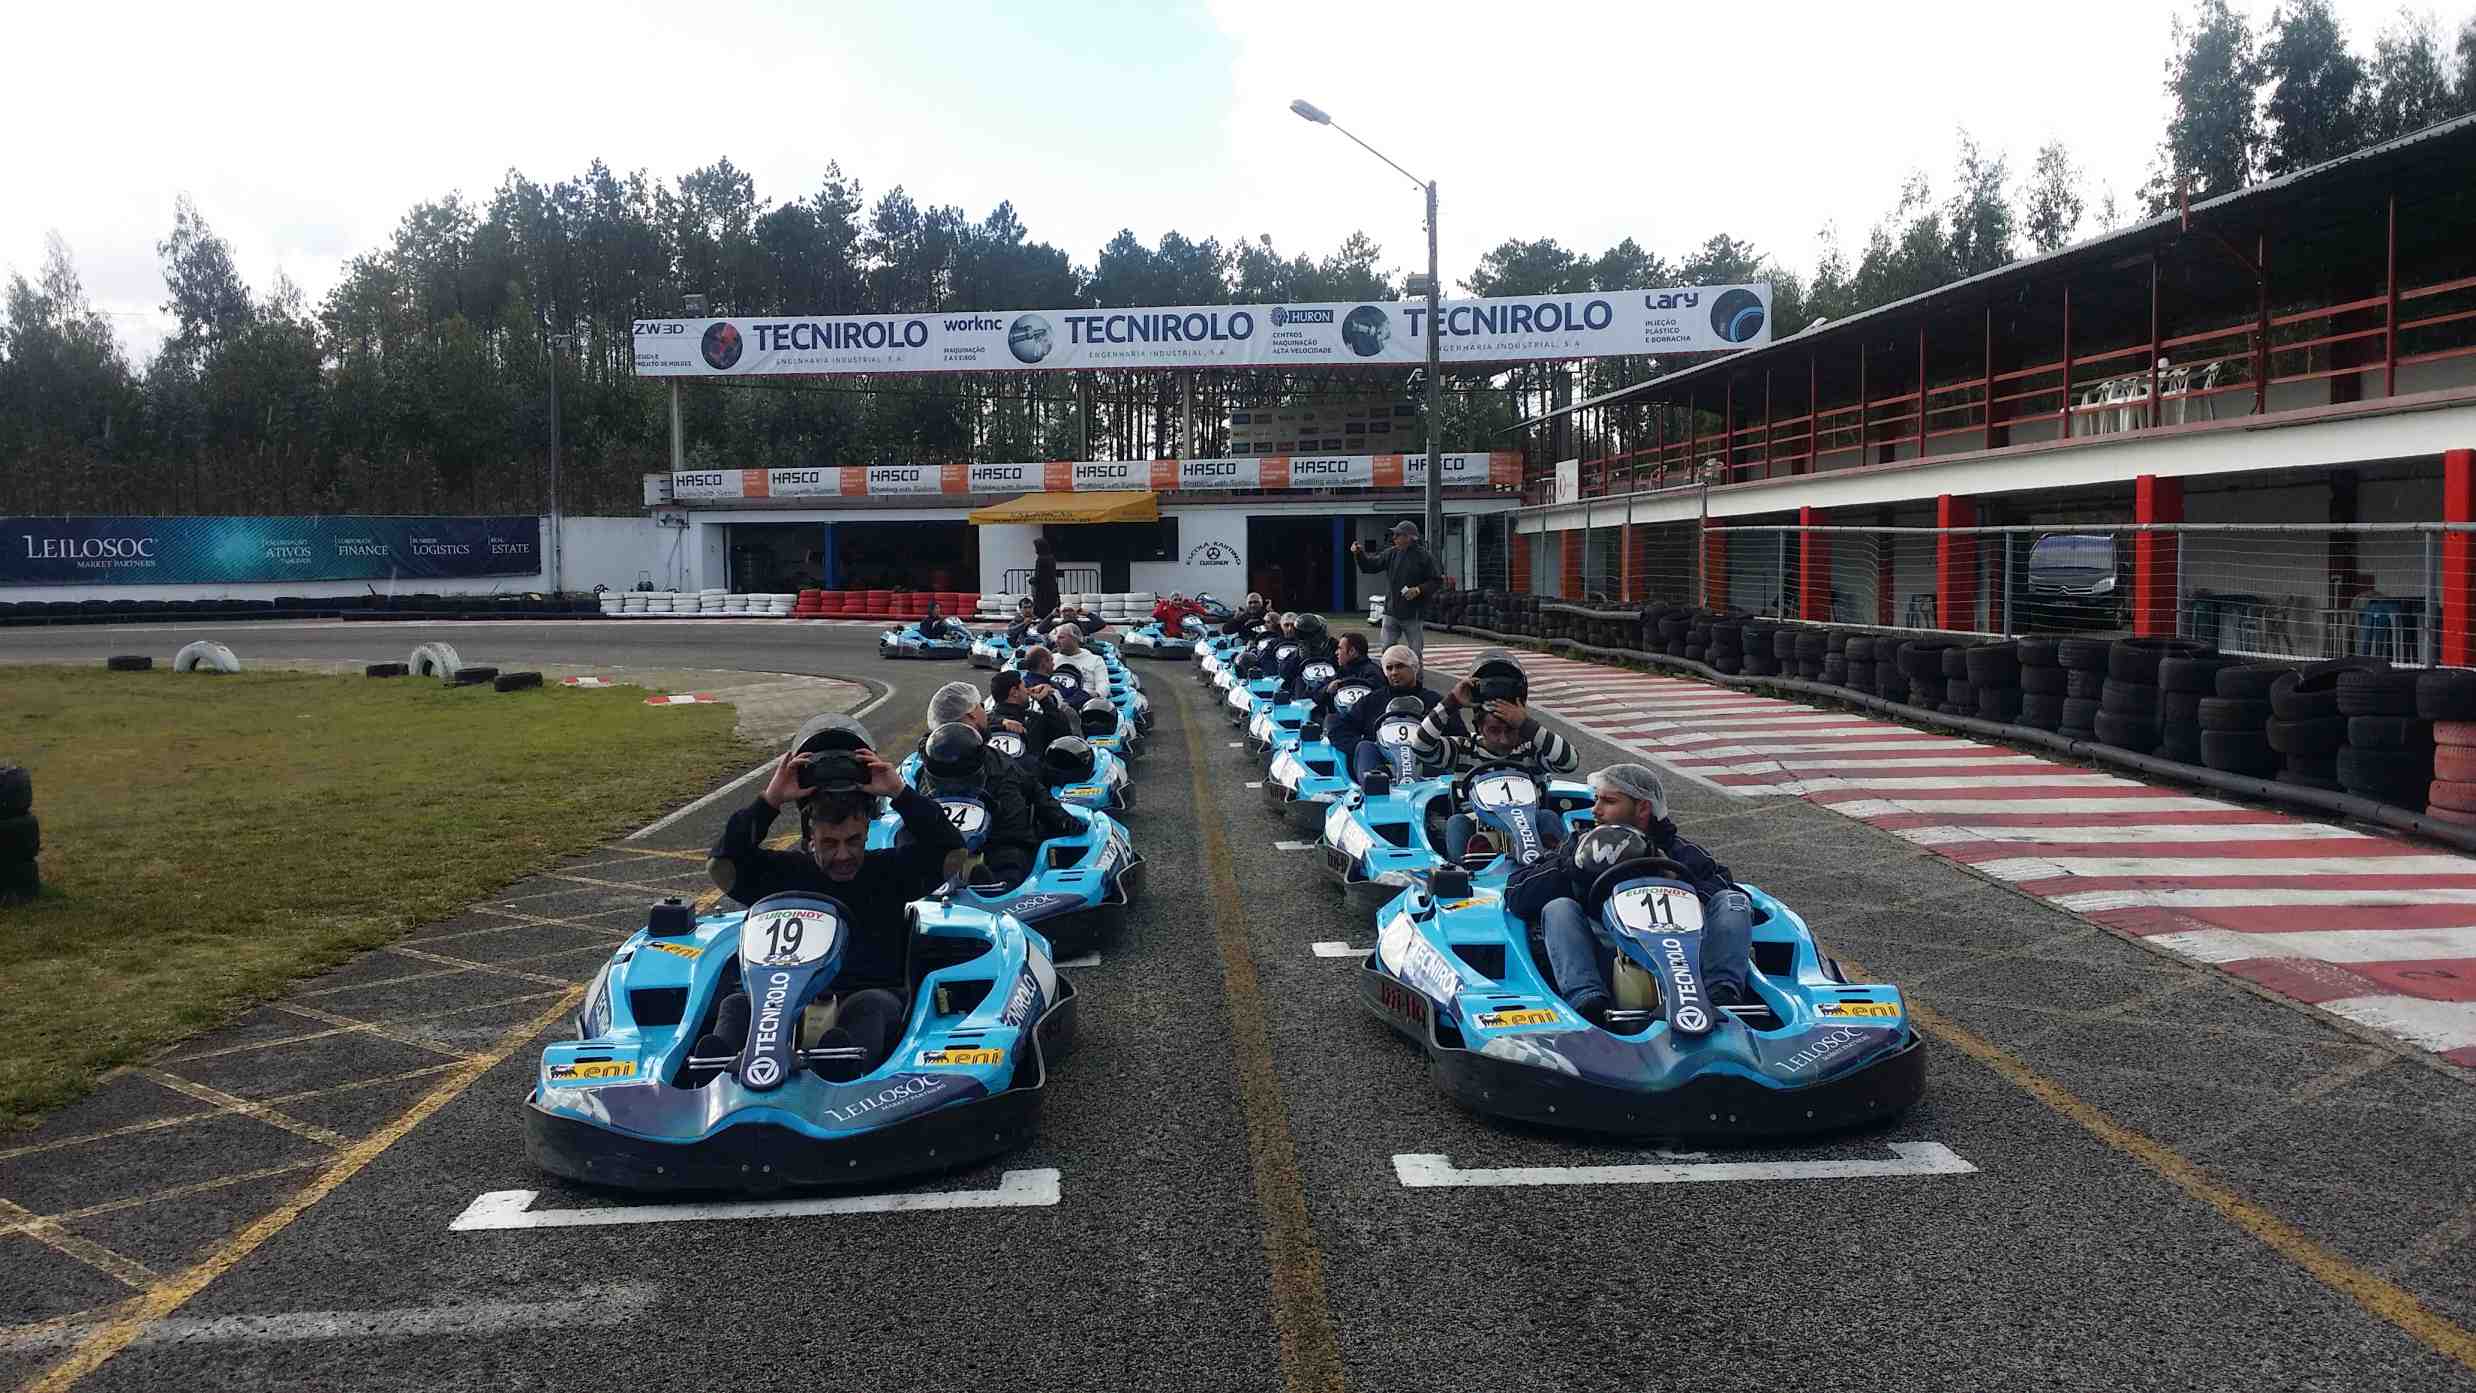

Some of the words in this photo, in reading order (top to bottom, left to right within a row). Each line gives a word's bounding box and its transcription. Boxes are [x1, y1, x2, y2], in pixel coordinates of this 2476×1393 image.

[1292, 312, 1330, 322] HURON
[1065, 312, 1254, 343] TECNIROLO
[753, 321, 928, 350] TECNIROLO
[1184, 463, 1236, 476] HASCO
[1294, 461, 1348, 473] HASCO
[1408, 458, 1464, 470] HACO
[772, 472, 819, 484] HASCO
[871, 470, 919, 481] HASCO
[972, 468, 1022, 480] HASCO
[1077, 466, 1127, 478] HASCO
[676, 474, 722, 486] HASCO
[22, 535, 154, 559] LEILOSOC
[338, 545, 388, 556] FINANCE
[413, 544, 470, 554] LOGISTICS
[492, 544, 529, 553] ESTATE
[77, 560, 112, 568] MARKET
[1399, 726, 1408, 740] 9
[1501, 782, 1512, 801] 1
[1008, 894, 1056, 912] LOSOC
[1640, 893, 1674, 924] 11
[766, 918, 803, 956] 19
[1662, 938, 1699, 1006] TECNIROLO
[755, 972, 790, 1056] TECNIROLO
[1511, 1010, 1553, 1024] eni
[1852, 1003, 1896, 1017] eni
[1775, 1025, 1863, 1072] LEILOSOC
[955, 1048, 1000, 1065] eni
[584, 1061, 630, 1078] eni
[824, 1074, 941, 1122] LEILOSOC
